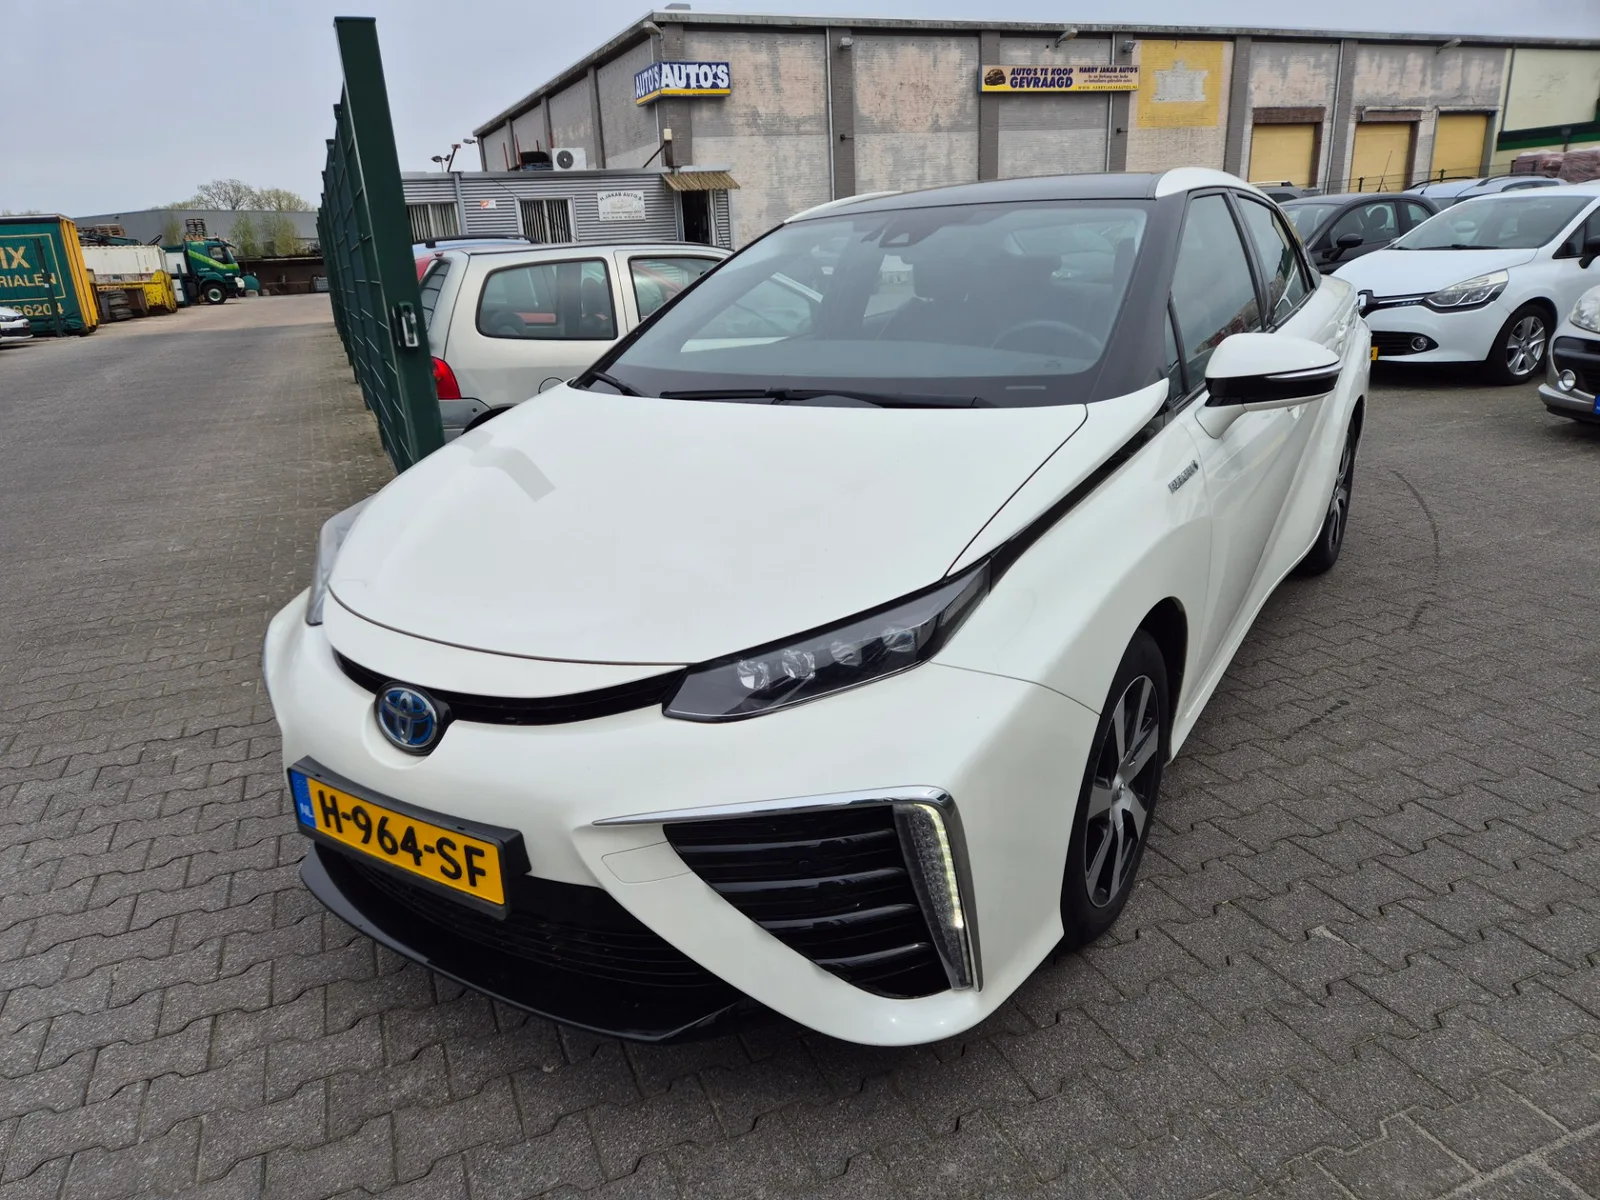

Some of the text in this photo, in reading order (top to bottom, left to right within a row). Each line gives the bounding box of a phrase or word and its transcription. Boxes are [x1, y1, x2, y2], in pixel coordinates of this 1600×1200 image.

[635, 66, 660, 99] AUTO'S
[661, 63, 729, 90] AUTO'S
[1010, 67, 1073, 76] AUTO'S TE KOOP
[1010, 76, 1073, 89] GEVRAAGD
[317, 789, 487, 888] H-964-SF
